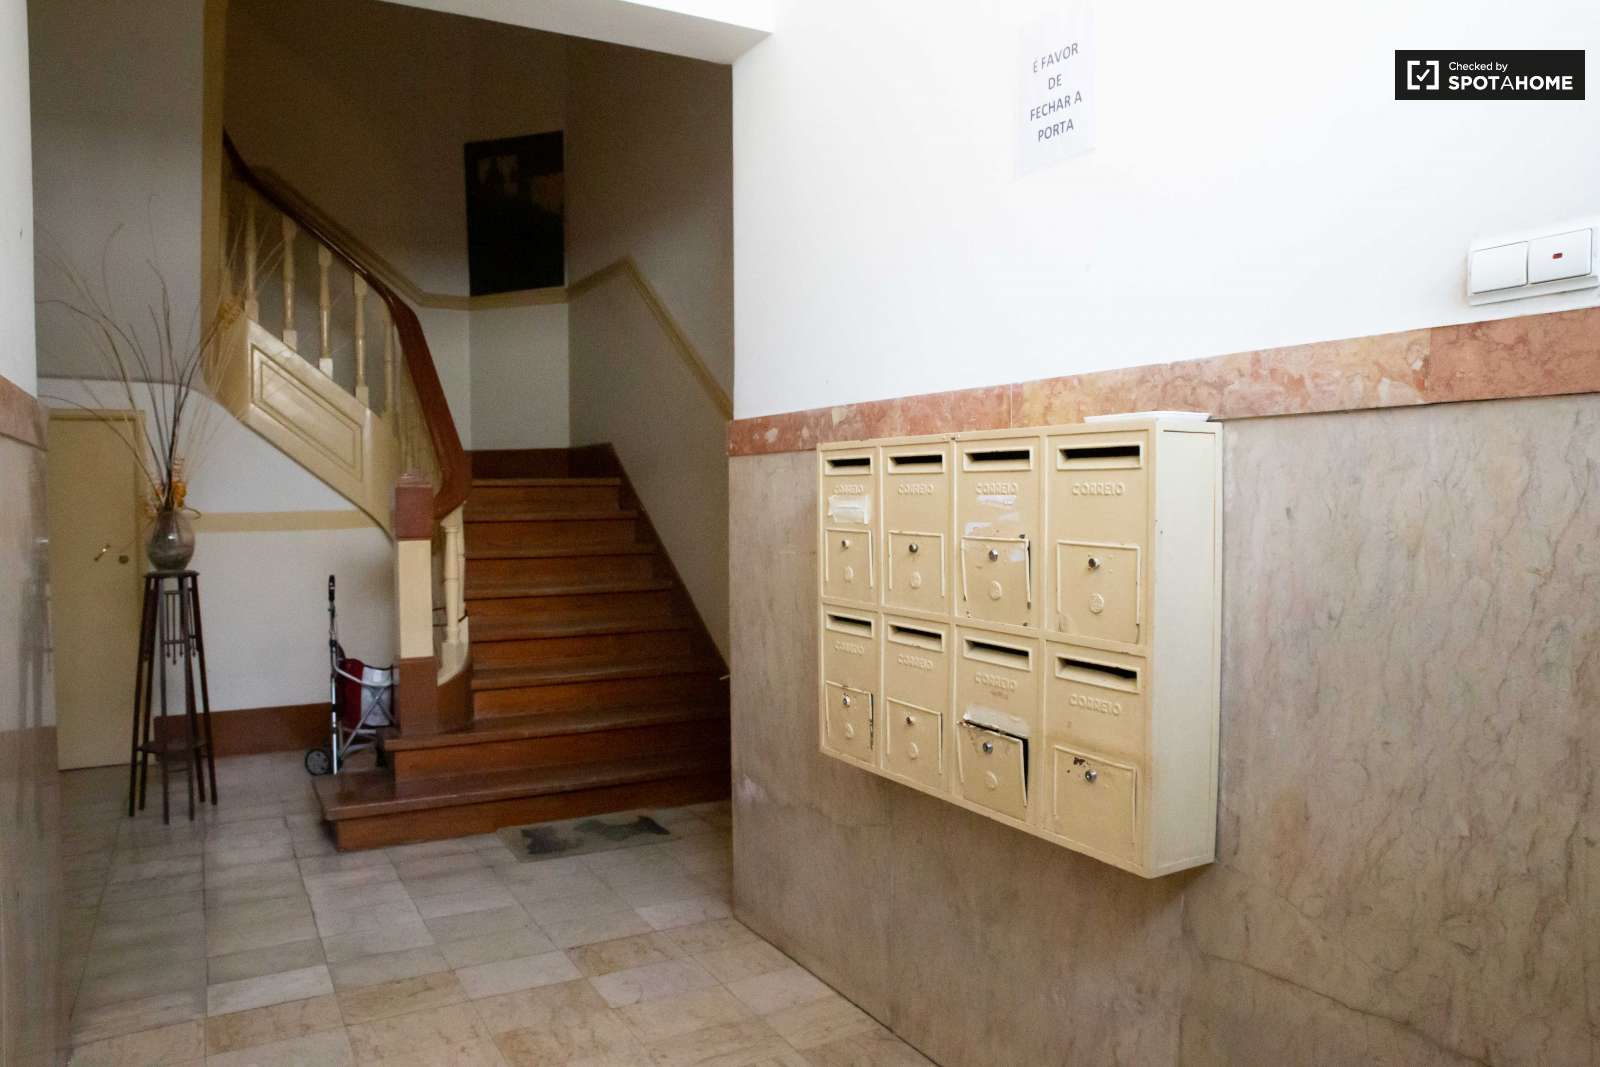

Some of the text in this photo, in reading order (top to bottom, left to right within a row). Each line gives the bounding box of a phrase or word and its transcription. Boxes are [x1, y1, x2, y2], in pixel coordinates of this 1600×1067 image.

[1041, 42, 1079, 70] FAVOR
[1048, 73, 1062, 90] DE
[1030, 90, 1082, 121] FECHAR A
[1038, 118, 1074, 142] PORTA
[974, 480, 1019, 496] CORREIO
[1072, 481, 1125, 496] CORREIO
[974, 671, 1018, 690] CORREIO
[1069, 692, 1122, 716] CORREIO
